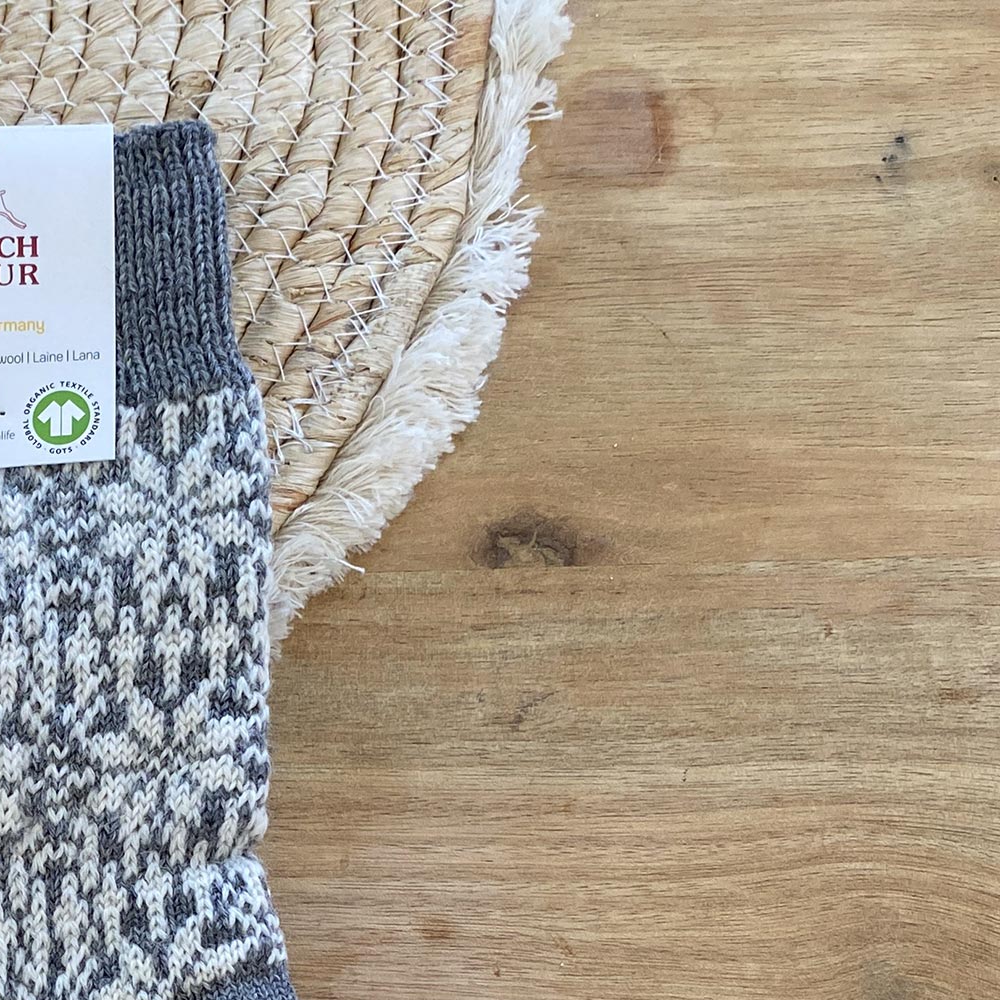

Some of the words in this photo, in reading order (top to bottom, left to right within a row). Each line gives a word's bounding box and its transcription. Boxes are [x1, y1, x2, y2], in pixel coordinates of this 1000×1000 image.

[33, 351, 63, 363] Laine
[73, 350, 100, 361] Lana
[24, 382, 55, 415] ORGANIC
[60, 381, 94, 399] TEXTILE
[23, 419, 42, 449] GLOBAL
[80, 401, 101, 445] STANDARD
